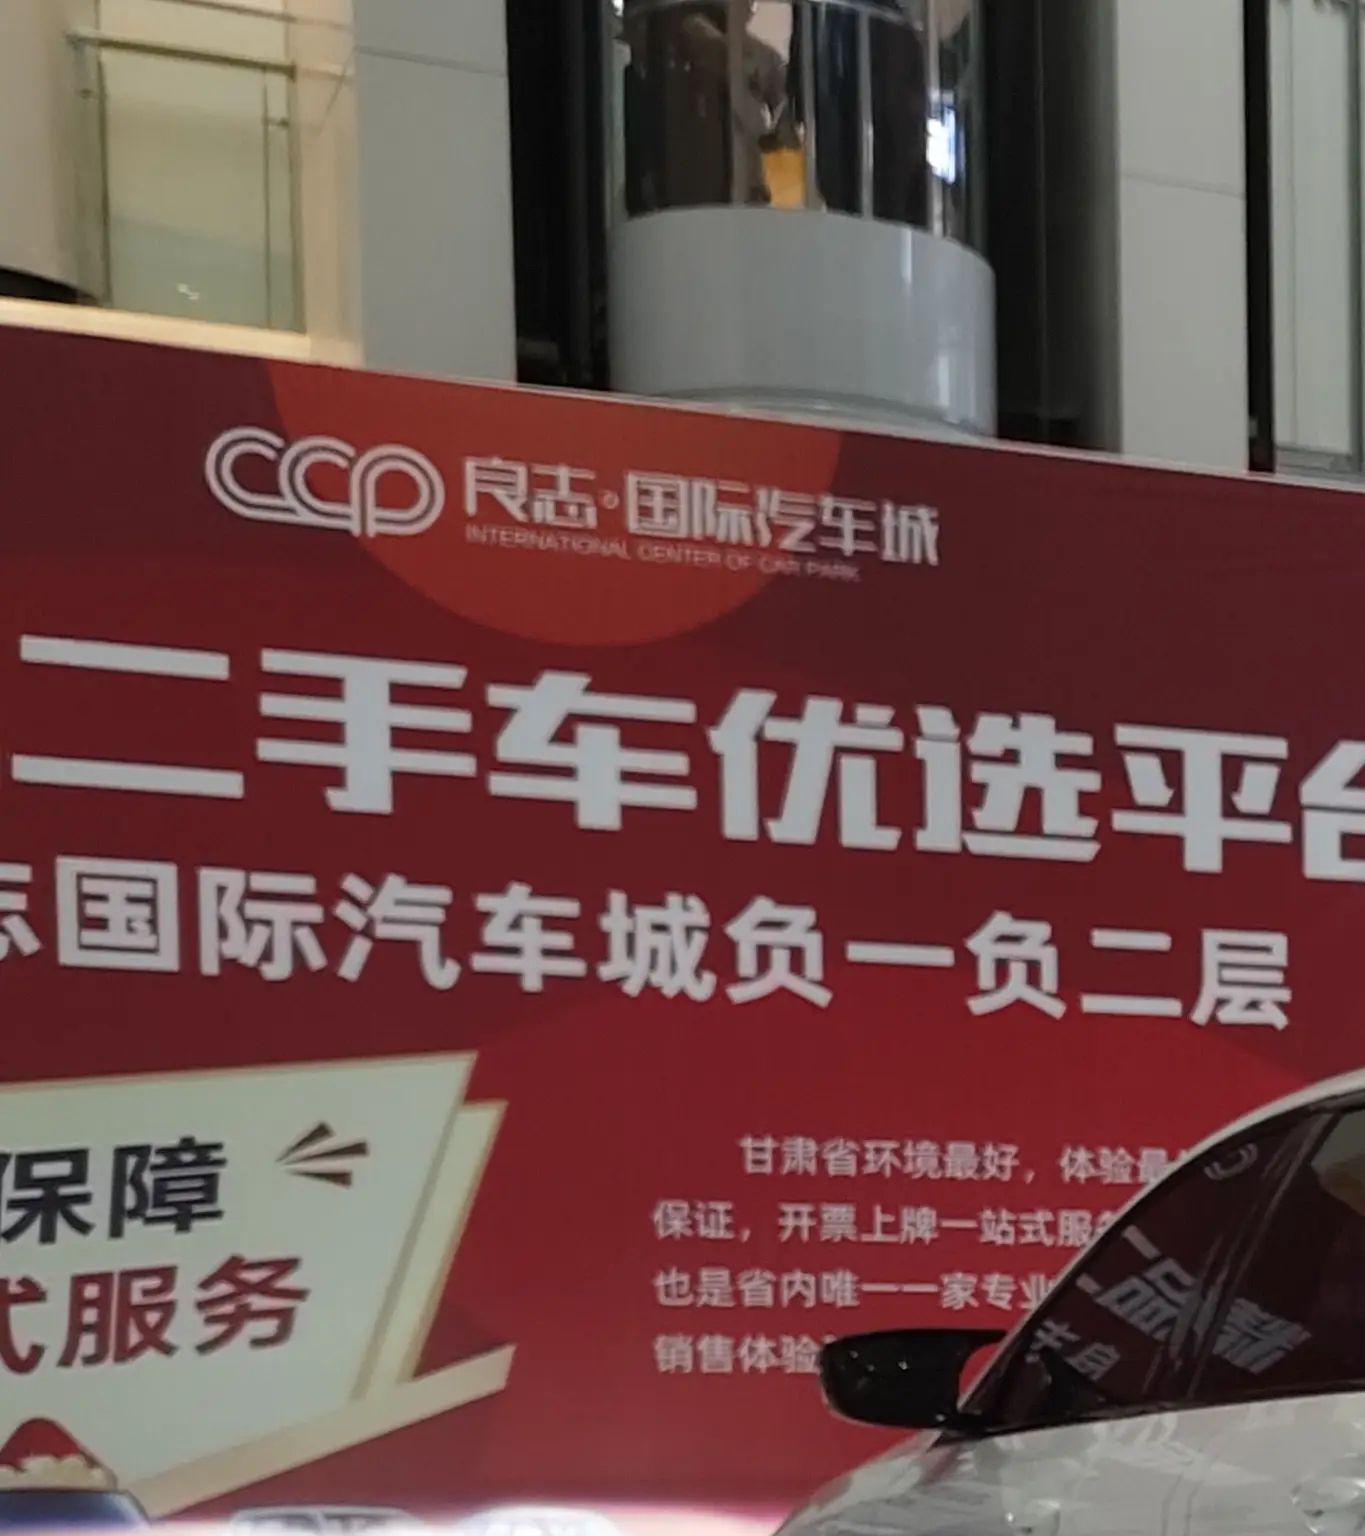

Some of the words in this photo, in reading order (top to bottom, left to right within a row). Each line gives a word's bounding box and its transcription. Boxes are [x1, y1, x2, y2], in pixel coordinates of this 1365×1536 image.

[465, 524, 631, 559] INTERNATIONAL
[637, 545, 721, 568] CENTER
[725, 554, 752, 572] OF
[738, 1134, 1190, 1184] 甘肃省环境最好，体验最
[0, 1136, 228, 1245] 保障
